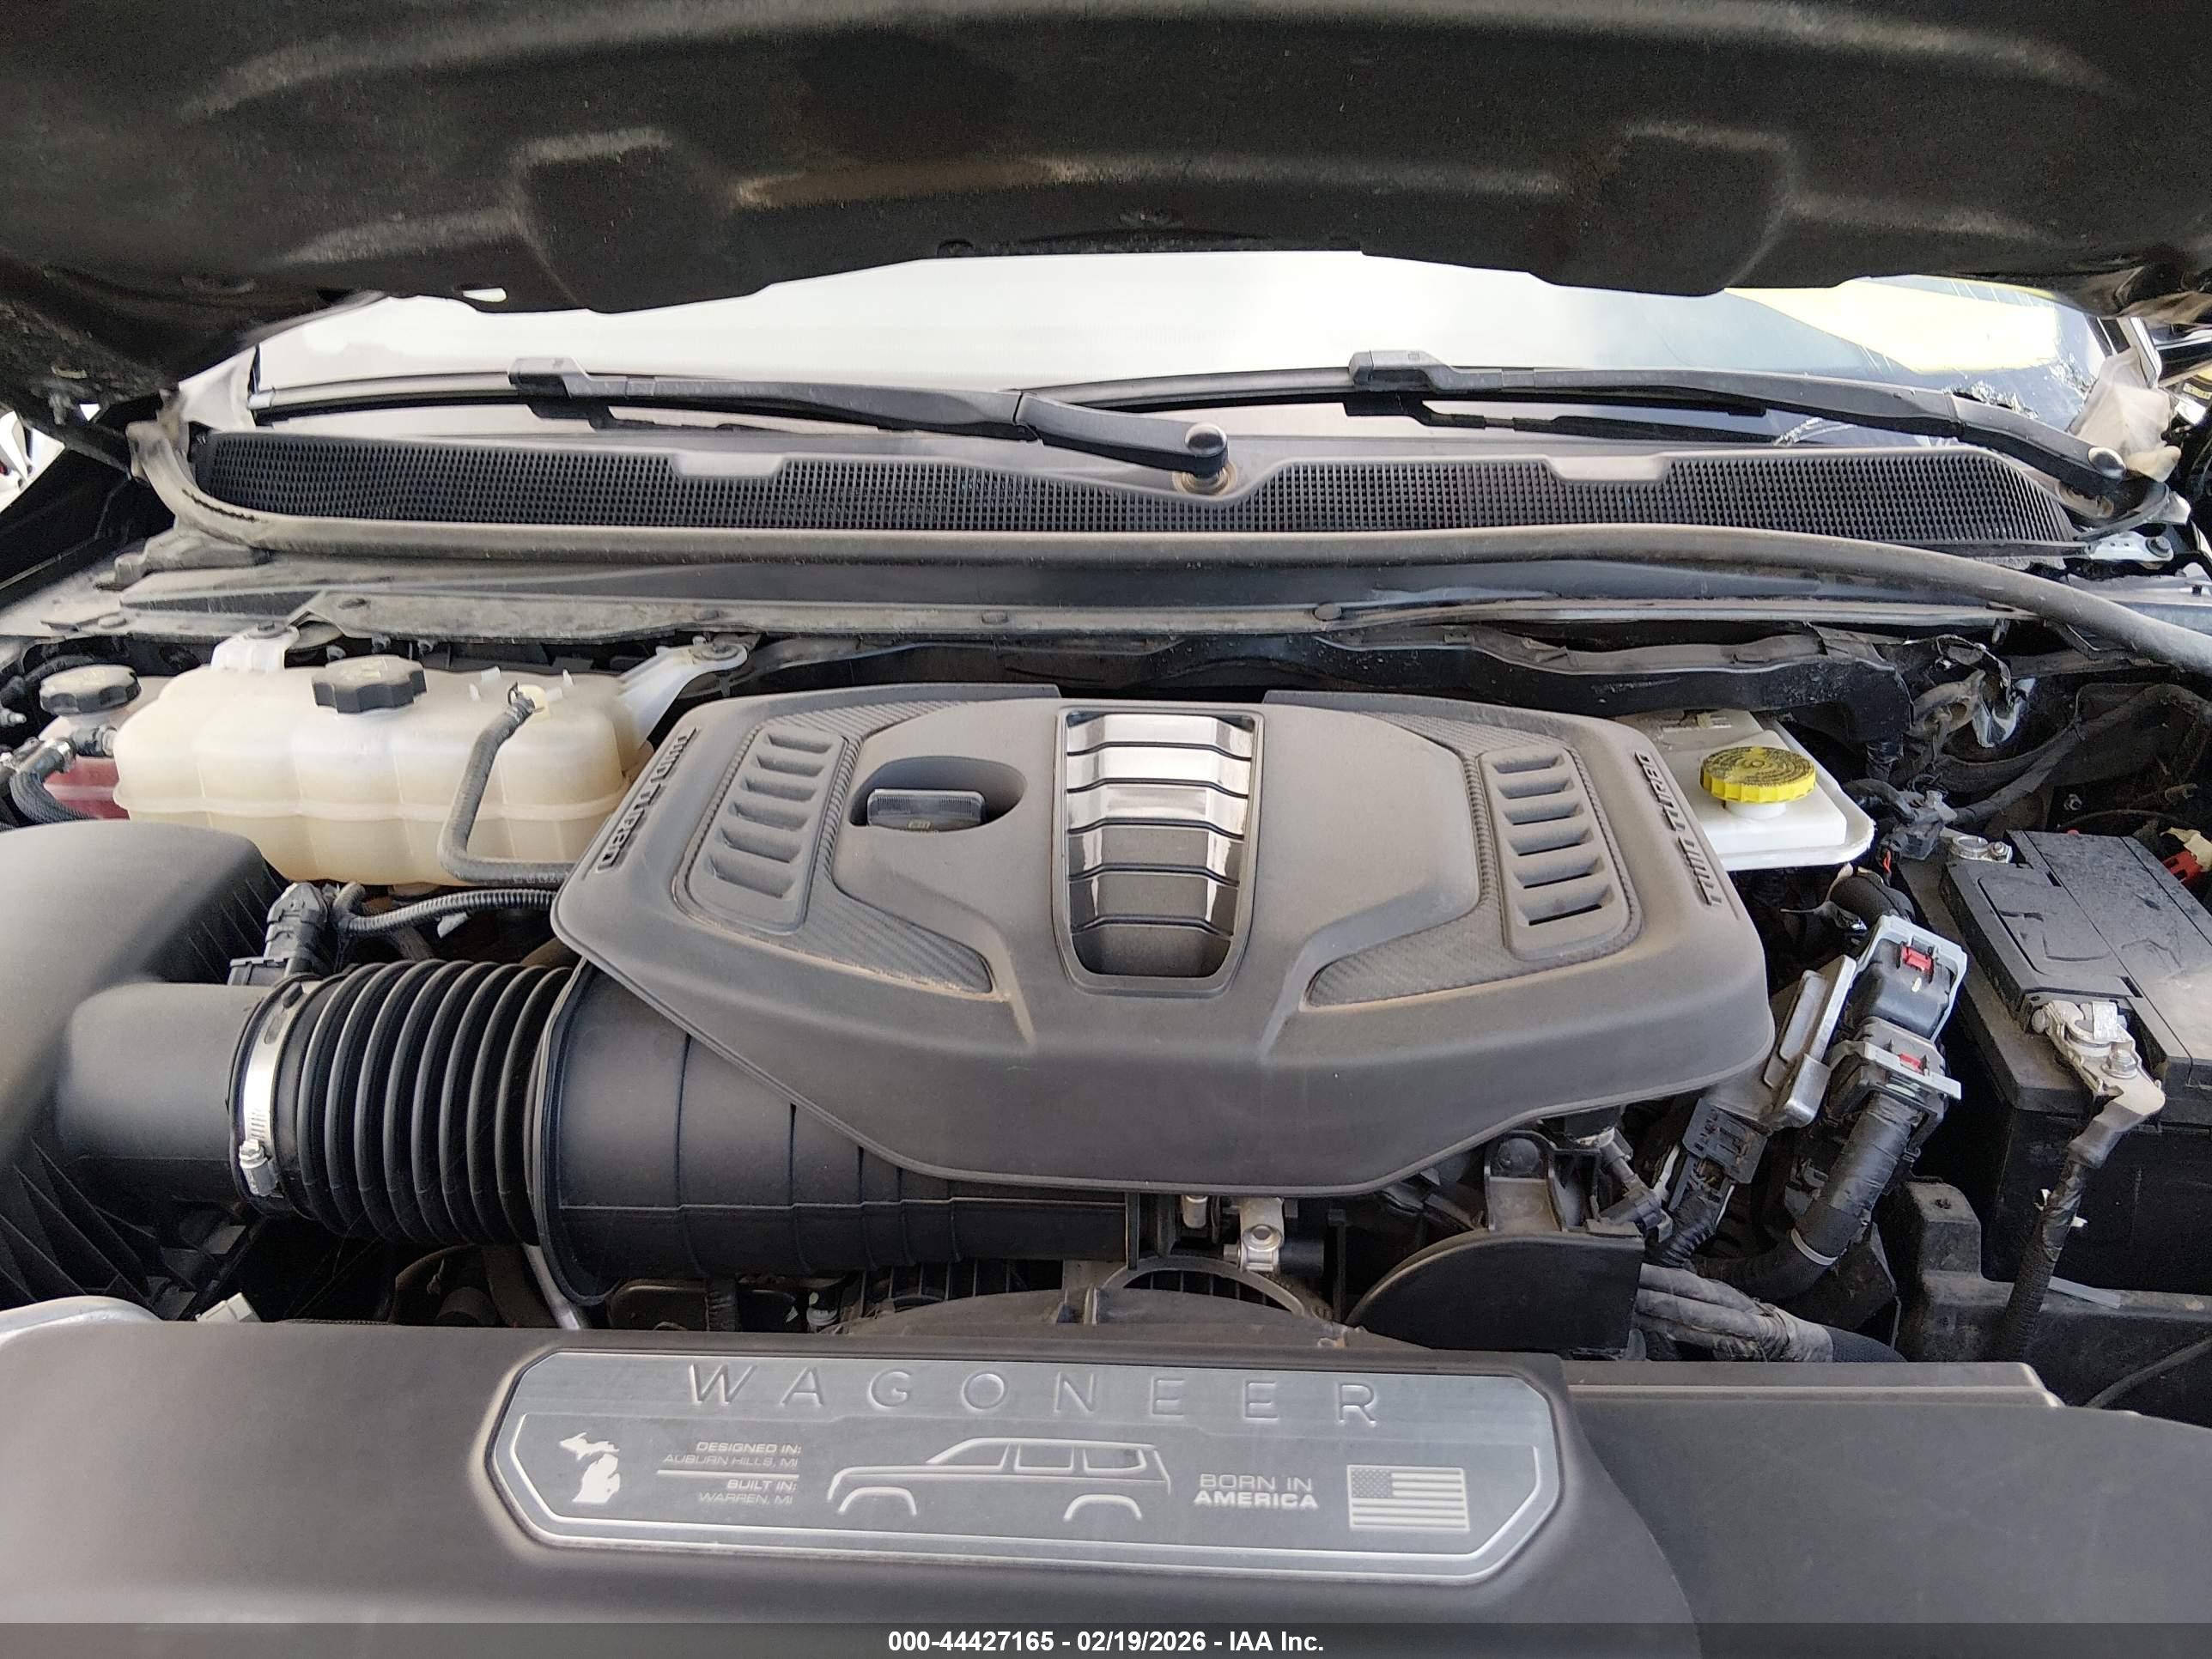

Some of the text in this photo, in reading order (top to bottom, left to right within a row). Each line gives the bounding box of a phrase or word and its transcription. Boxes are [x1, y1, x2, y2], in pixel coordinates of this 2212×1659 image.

[597, 726, 700, 873] TWIN TURBO
[1634, 750, 1723, 907] TWIN TURBO
[689, 1363, 1376, 1425] WAGONEER
[696, 1441, 802, 1455] DESIGNED IN:
[663, 1454, 728, 1466] AUBURN
[780, 1457, 799, 1468] MI
[726, 1479, 772, 1492] BUILT
[1200, 1473, 1313, 1492] BORN IN
[699, 1492, 793, 1505] WARREN, MI
[1194, 1490, 1319, 1510] AMERICA
